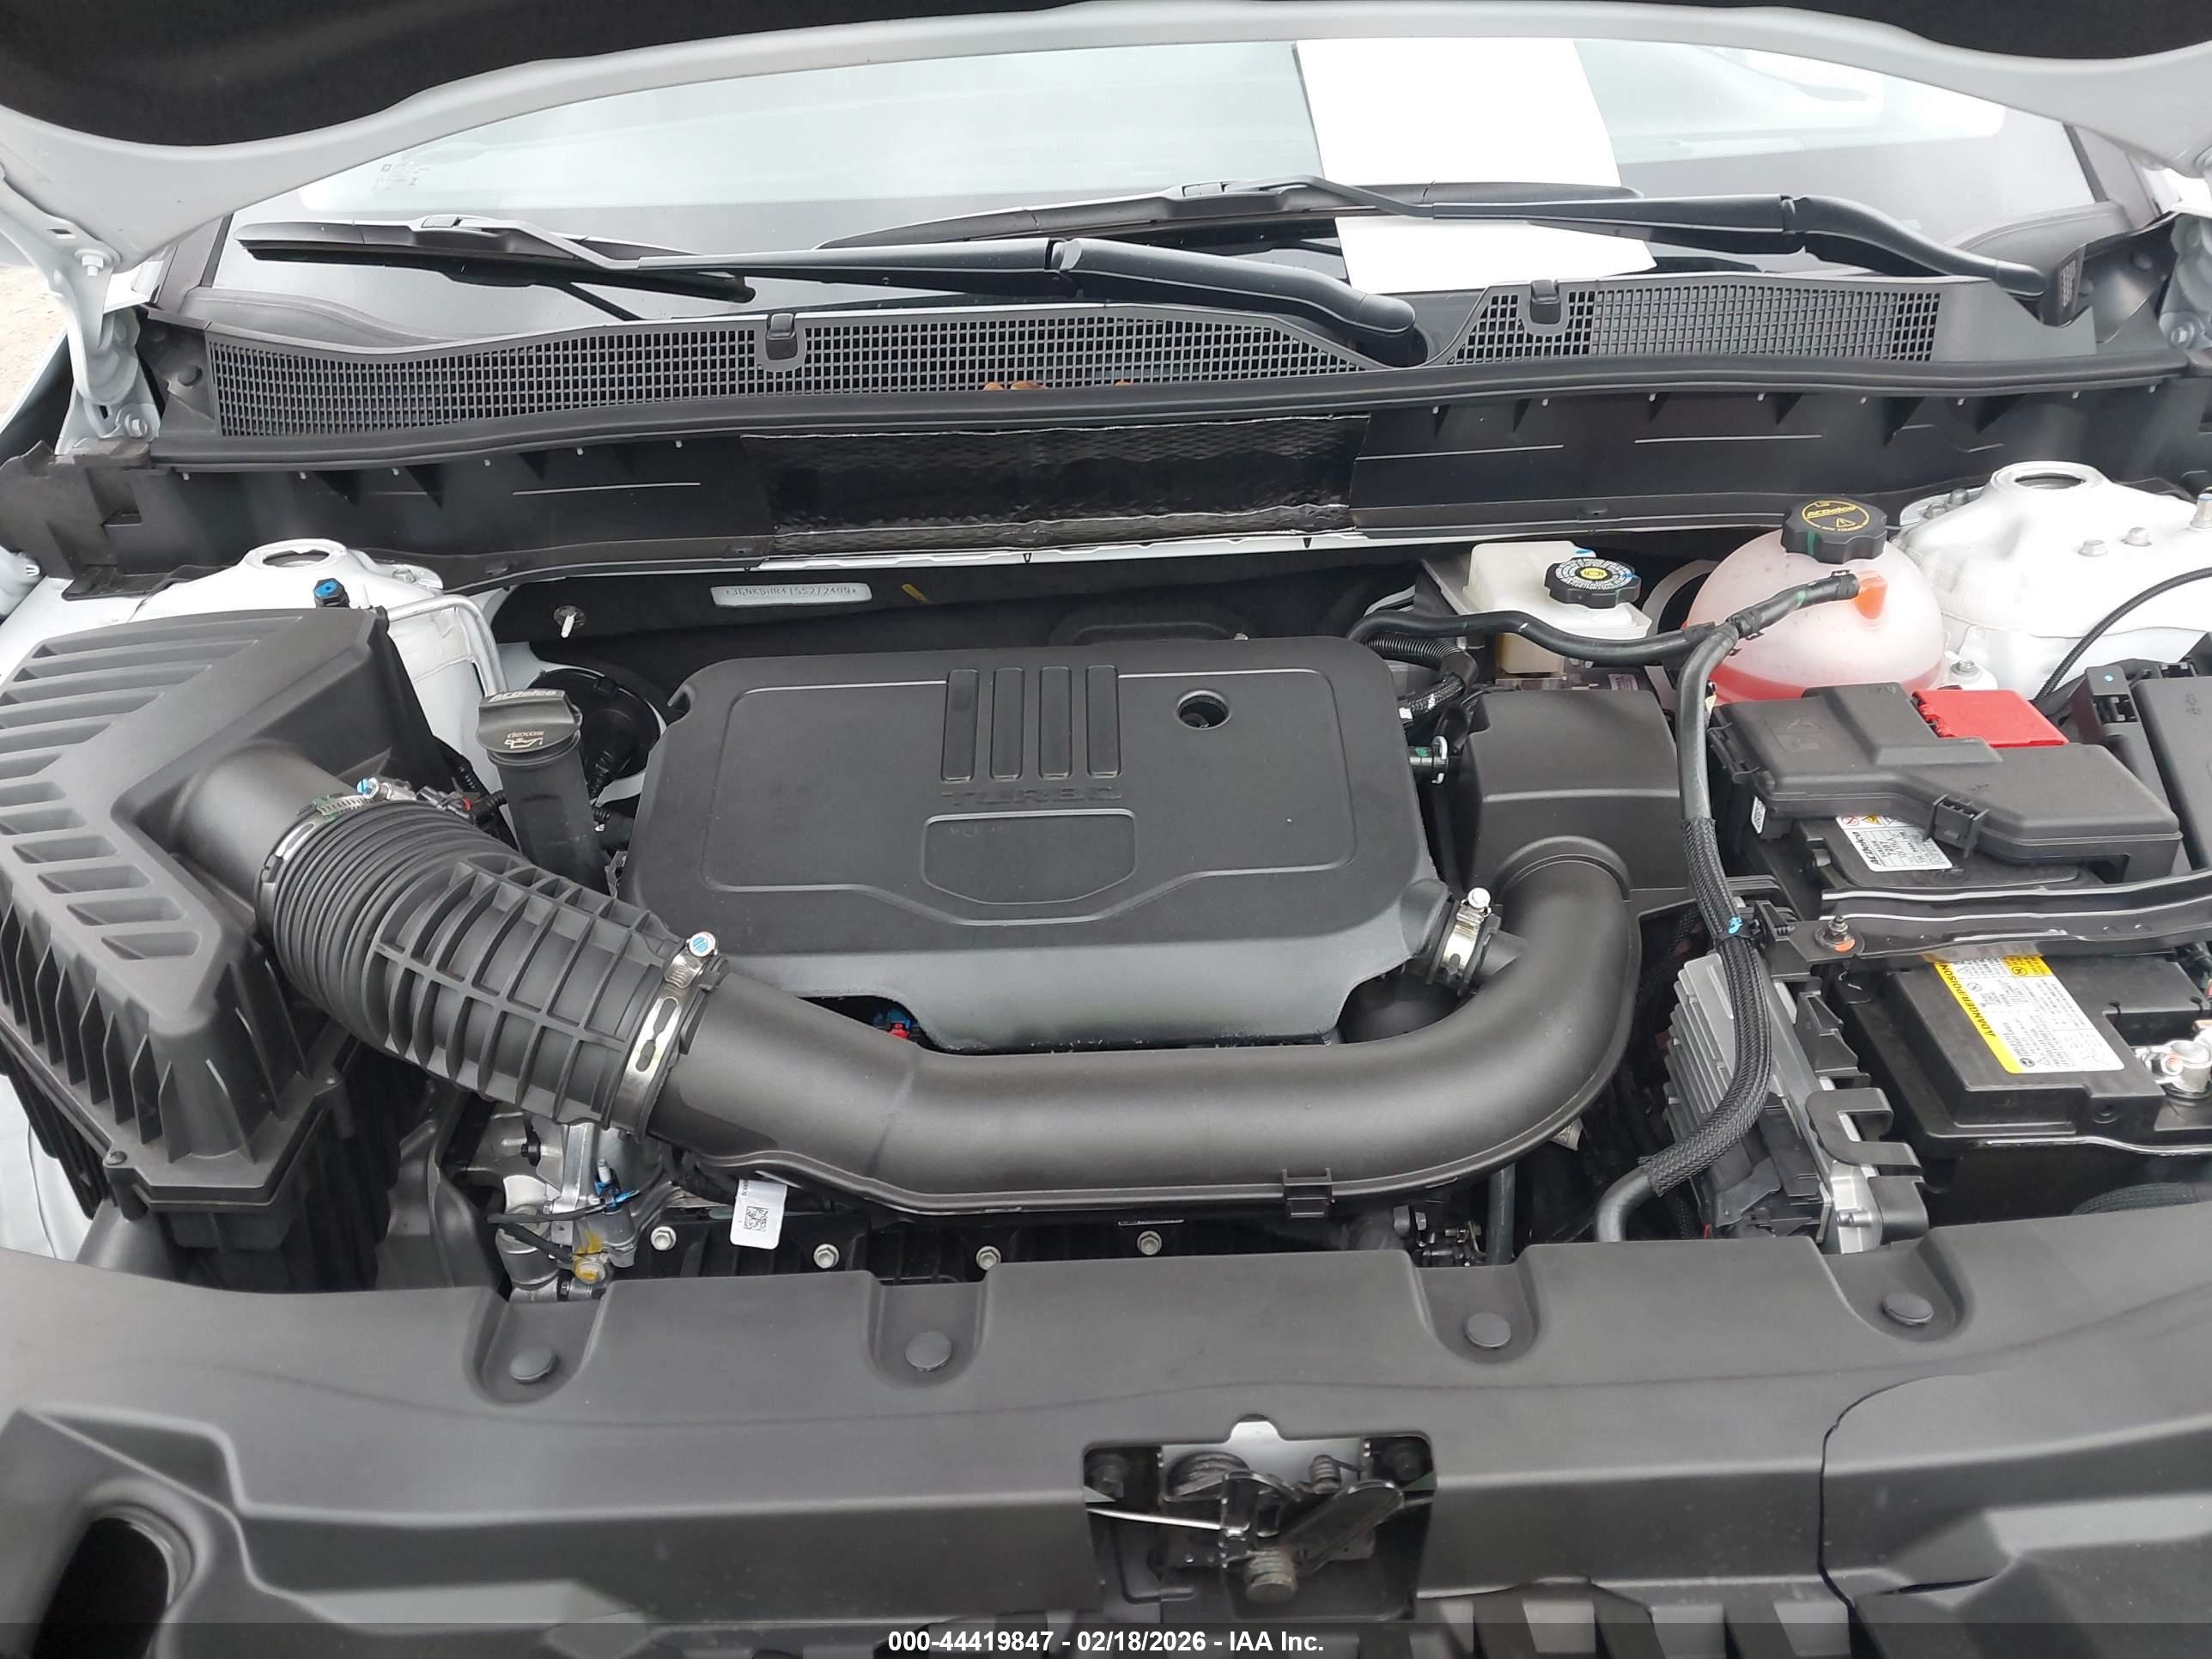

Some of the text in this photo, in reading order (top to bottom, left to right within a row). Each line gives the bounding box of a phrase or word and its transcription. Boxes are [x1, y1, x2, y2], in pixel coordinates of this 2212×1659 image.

[487, 690, 557, 703] ACDelco
[507, 730, 545, 739] dexos
[940, 785, 1122, 807] TURBO
[1851, 831, 1882, 866] ACDelco
[1939, 963, 1994, 1031] DANGER/POISON
